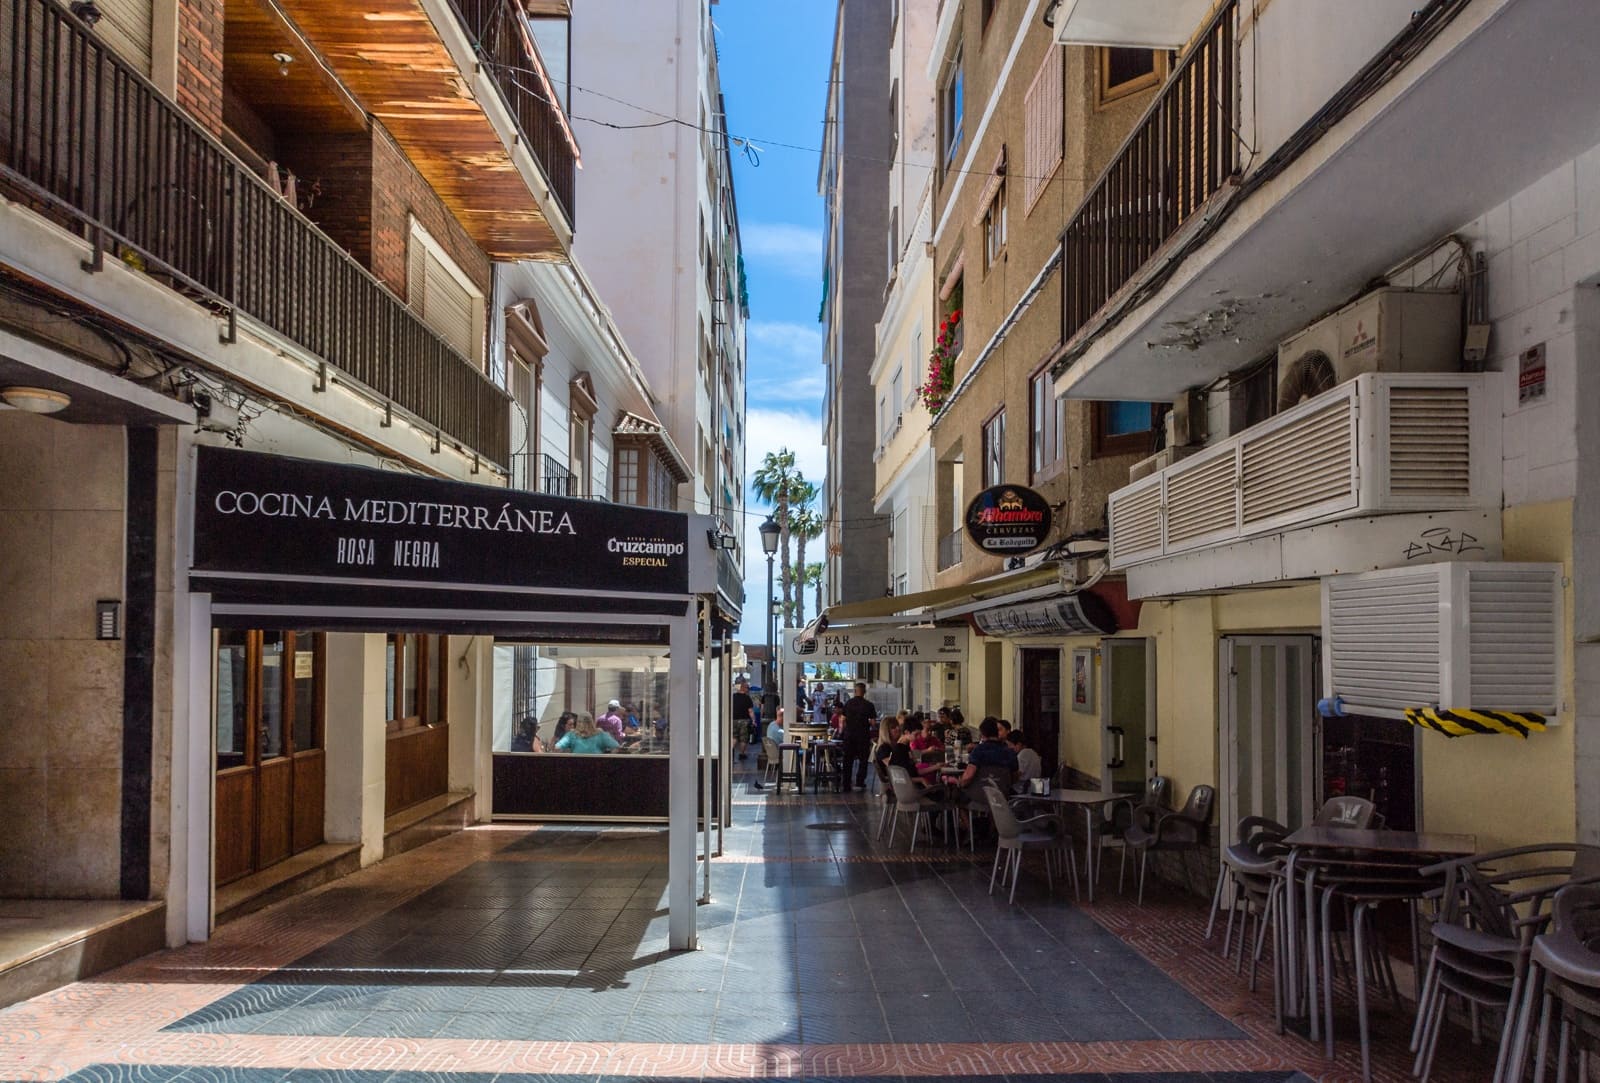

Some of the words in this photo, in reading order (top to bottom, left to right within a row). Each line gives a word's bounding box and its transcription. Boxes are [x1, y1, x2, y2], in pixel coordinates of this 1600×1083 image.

[215, 490, 336, 520] COCINA
[343, 498, 577, 536] MEDITERRÁNEA
[977, 507, 1042, 524] Alhambra
[337, 537, 375, 566] ROSA
[393, 540, 440, 568] NEGRA
[607, 537, 684, 556] Cruzcampo
[622, 556, 668, 567] ESPECIAL
[824, 635, 850, 644] BAR
[824, 645, 844, 656] LA
[845, 644, 919, 656] BODEGUITA
